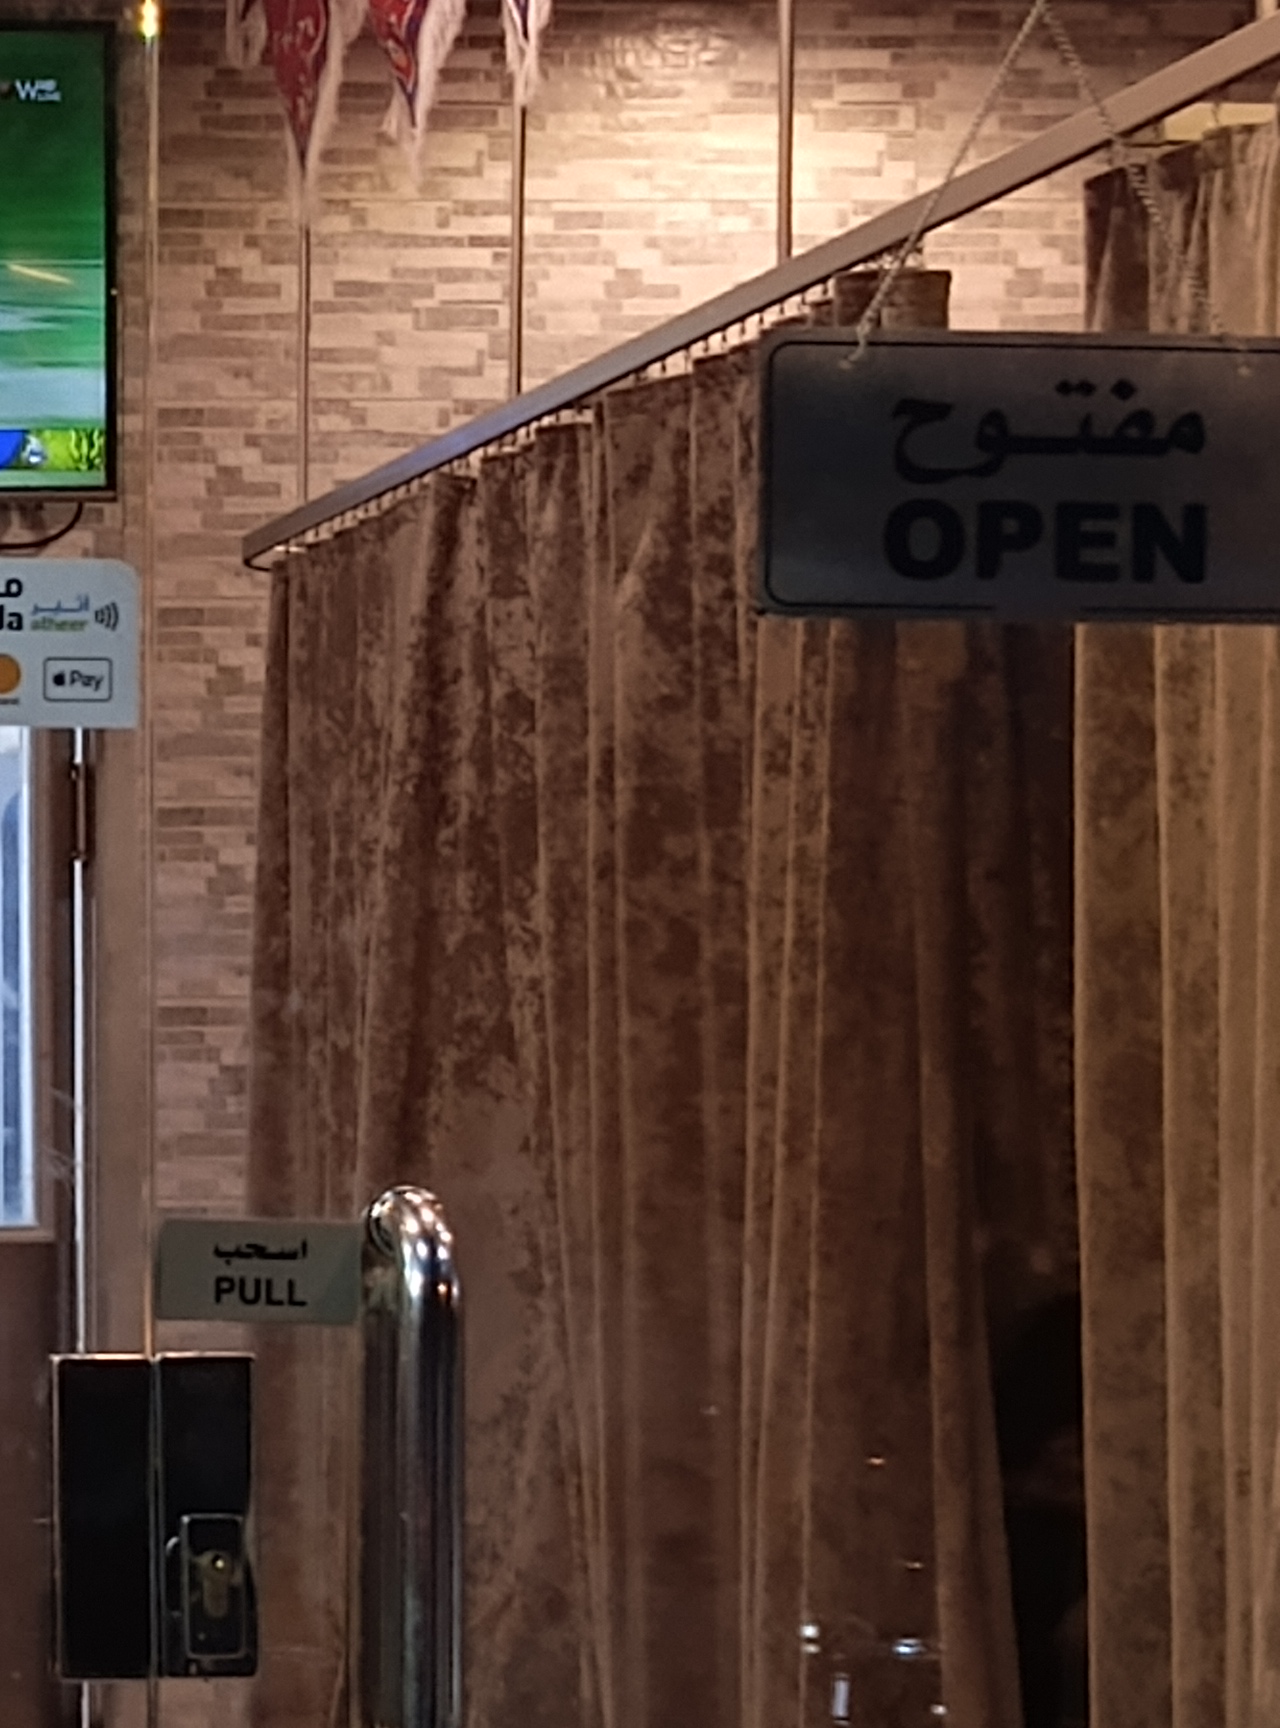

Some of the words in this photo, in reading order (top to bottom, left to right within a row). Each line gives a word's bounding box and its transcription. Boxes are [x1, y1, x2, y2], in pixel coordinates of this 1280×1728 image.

[891, 378, 1207, 485] مفتوح
[883, 498, 1209, 585] OPEN
[69, 670, 105, 692] Pay
[213, 1238, 308, 1266] اسحب
[214, 1275, 308, 1308] PULL
